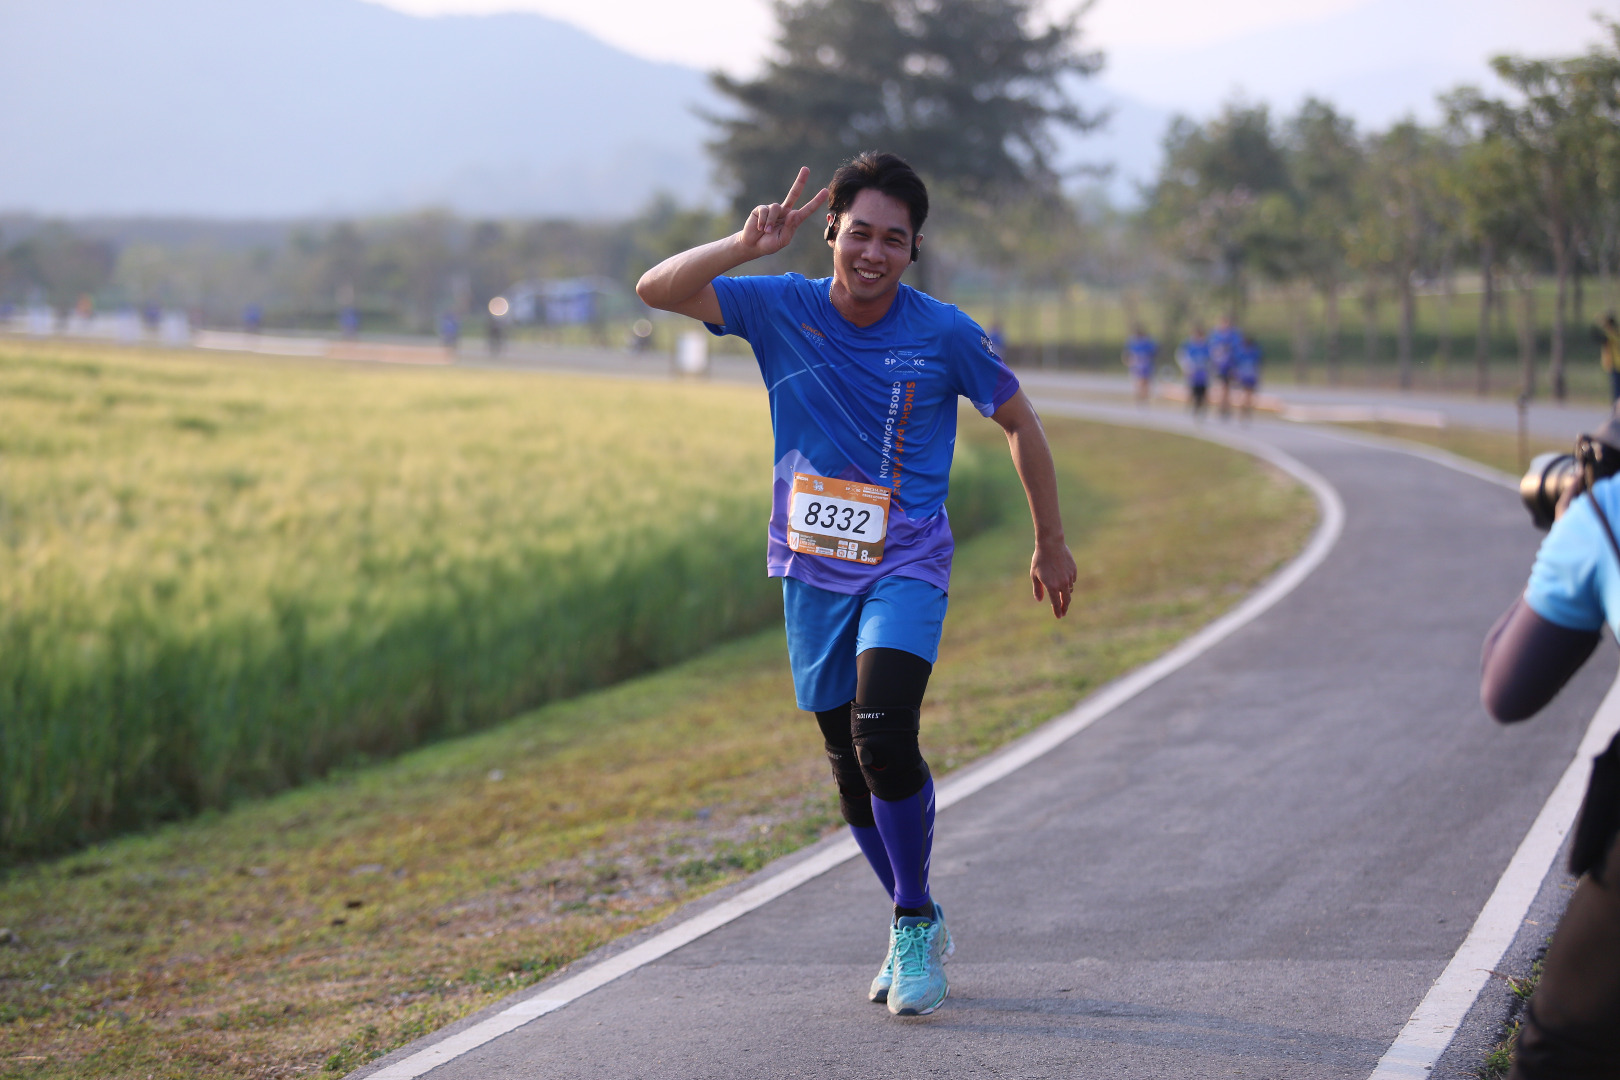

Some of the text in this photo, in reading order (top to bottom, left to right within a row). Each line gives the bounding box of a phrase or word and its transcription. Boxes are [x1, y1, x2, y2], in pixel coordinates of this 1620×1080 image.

[884, 357, 897, 365] SP
[898, 381, 916, 426] SINGHA
[879, 381, 901, 479] CROSS COUNTRY RUN
[895, 428, 905, 454] PARK
[804, 501, 871, 535] 8332
[861, 550, 868, 561] 8
